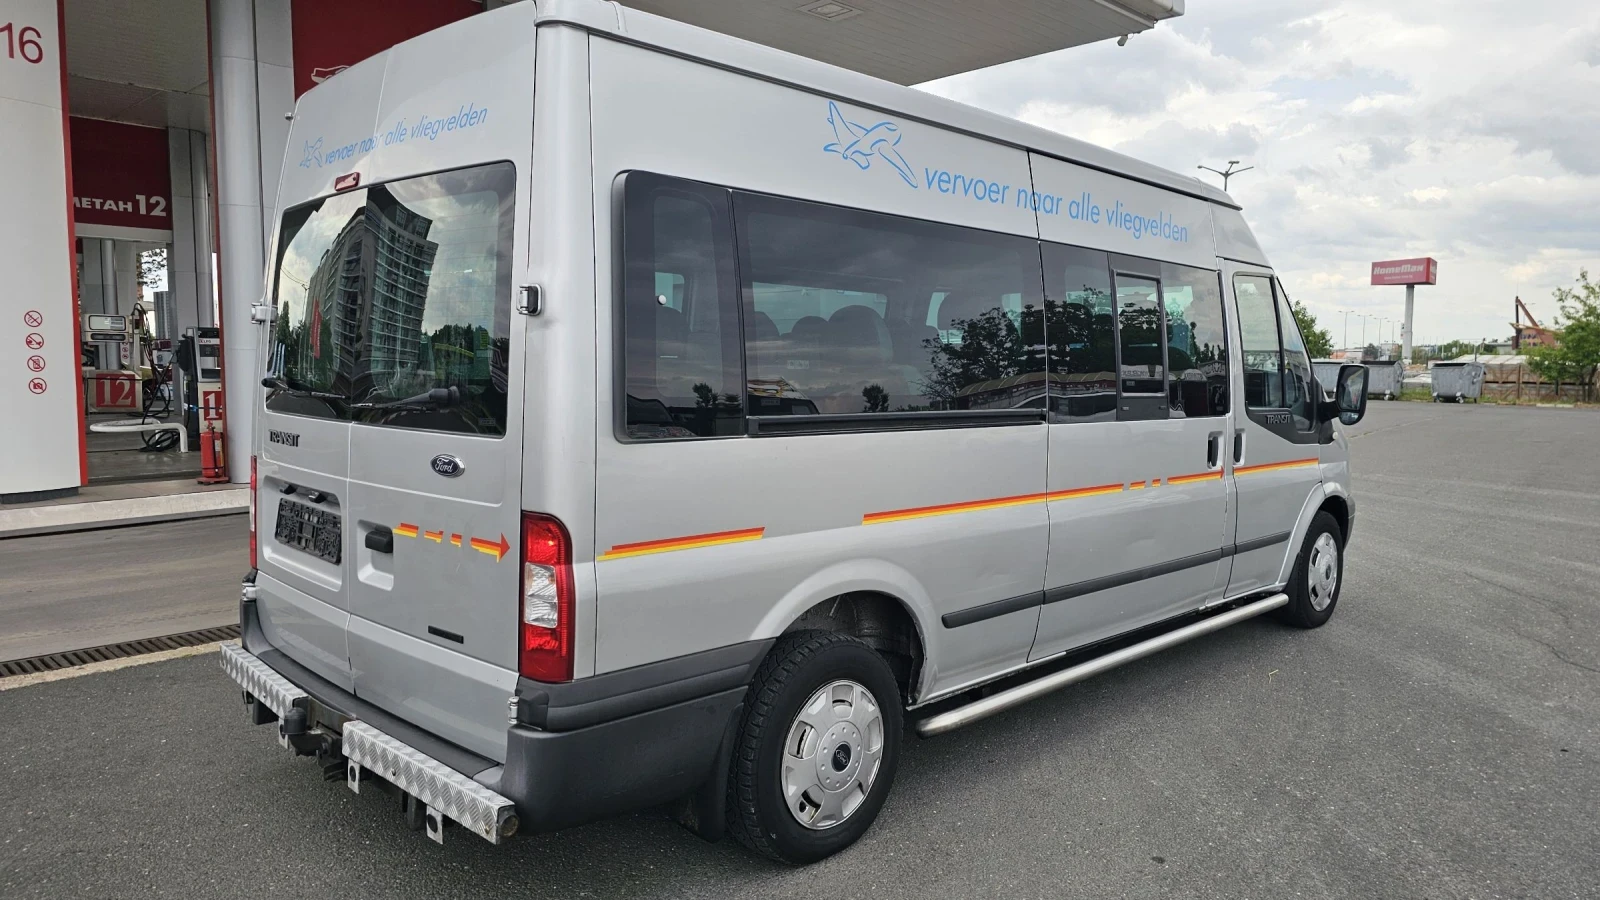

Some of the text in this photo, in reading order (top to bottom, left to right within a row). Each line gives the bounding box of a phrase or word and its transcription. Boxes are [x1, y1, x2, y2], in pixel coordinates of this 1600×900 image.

[0, 22, 43, 64] 16
[325, 142, 358, 164] vervoer
[385, 120, 407, 146] alle
[411, 102, 488, 141] vliegvelden
[135, 194, 167, 216] 12
[925, 168, 1188, 243] vervoer naar alle vliegvelden
[100, 376, 132, 407] 12
[1265, 414, 1290, 424] TRANSIT
[268, 429, 300, 447] TRANSIT
[434, 457, 454, 473] Ford
